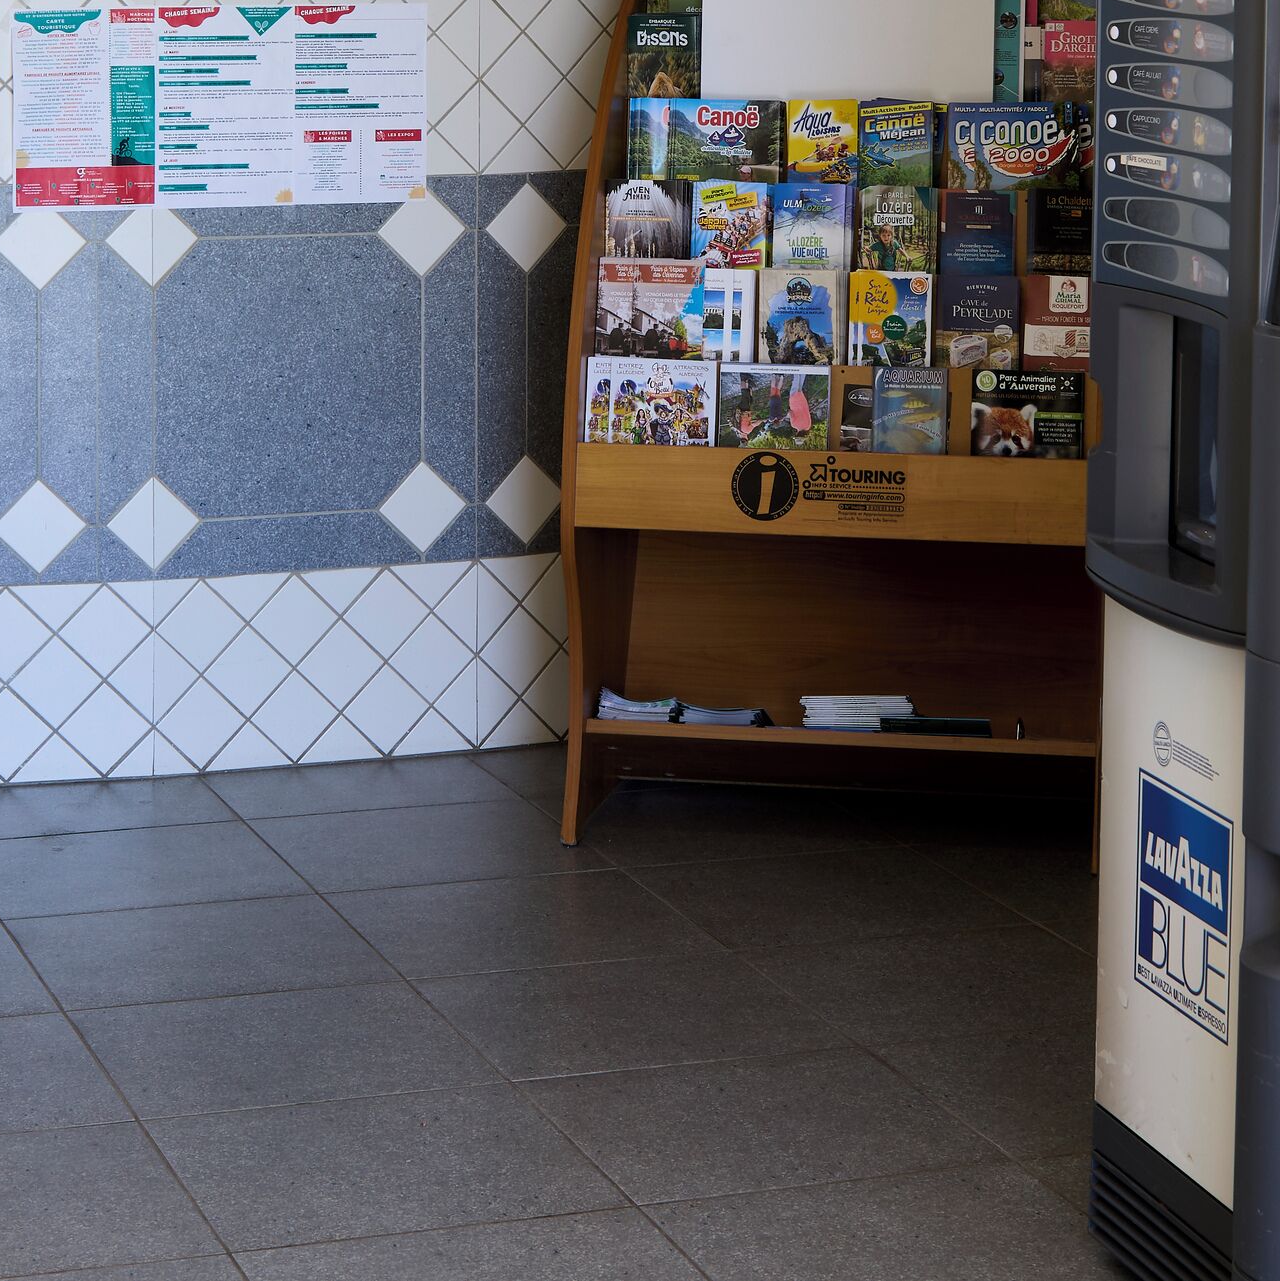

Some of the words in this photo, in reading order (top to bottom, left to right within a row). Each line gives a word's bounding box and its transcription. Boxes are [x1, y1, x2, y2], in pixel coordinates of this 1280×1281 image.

[164, 10, 188, 18] CHAQUE
[190, 7, 215, 15] SEMAINE
[300, 8, 323, 16] CHAQUE
[863, 107, 905, 116] Multi-Activités
[909, 104, 929, 112] Paddle
[697, 106, 759, 129] Canoë
[794, 103, 832, 137] Aqua
[864, 113, 925, 133] Canoë
[812, 126, 841, 137] LOISIRS
[880, 128, 925, 142] Méjean
[980, 114, 1058, 146] canoë
[990, 148, 1050, 164] 2000
[783, 200, 803, 208] ULM
[876, 198, 913, 213] Lozère
[1047, 196, 1056, 205] La
[876, 215, 913, 224] Découverte
[797, 236, 823, 247] LOZÈRE
[792, 247, 806, 258] VUE
[814, 247, 829, 258] CIEL
[869, 279, 881, 290] Sur
[865, 291, 889, 306] Rails
[1056, 292, 1081, 300] Maria
[867, 307, 888, 317] Larzac
[952, 305, 1014, 323] PEYRELADE
[619, 363, 644, 371] ENTREZ
[673, 365, 709, 373] ATTRACTIONS
[883, 369, 944, 384] AQUARIUM
[999, 374, 1017, 382] Parc
[1020, 375, 1056, 384] Animalier
[830, 468, 906, 485] TOURING
[827, 492, 902, 504] www.touringinfo.com
[1144, 831, 1224, 912] LAVAZZA
[1138, 888, 1227, 1016] BLUE
[1137, 963, 1152, 982] BEST
[1151, 972, 1173, 997] LAVAZZA
[1173, 986, 1198, 1015] ULTIMATE
[1198, 1006, 1227, 1034] ESPRESSO
